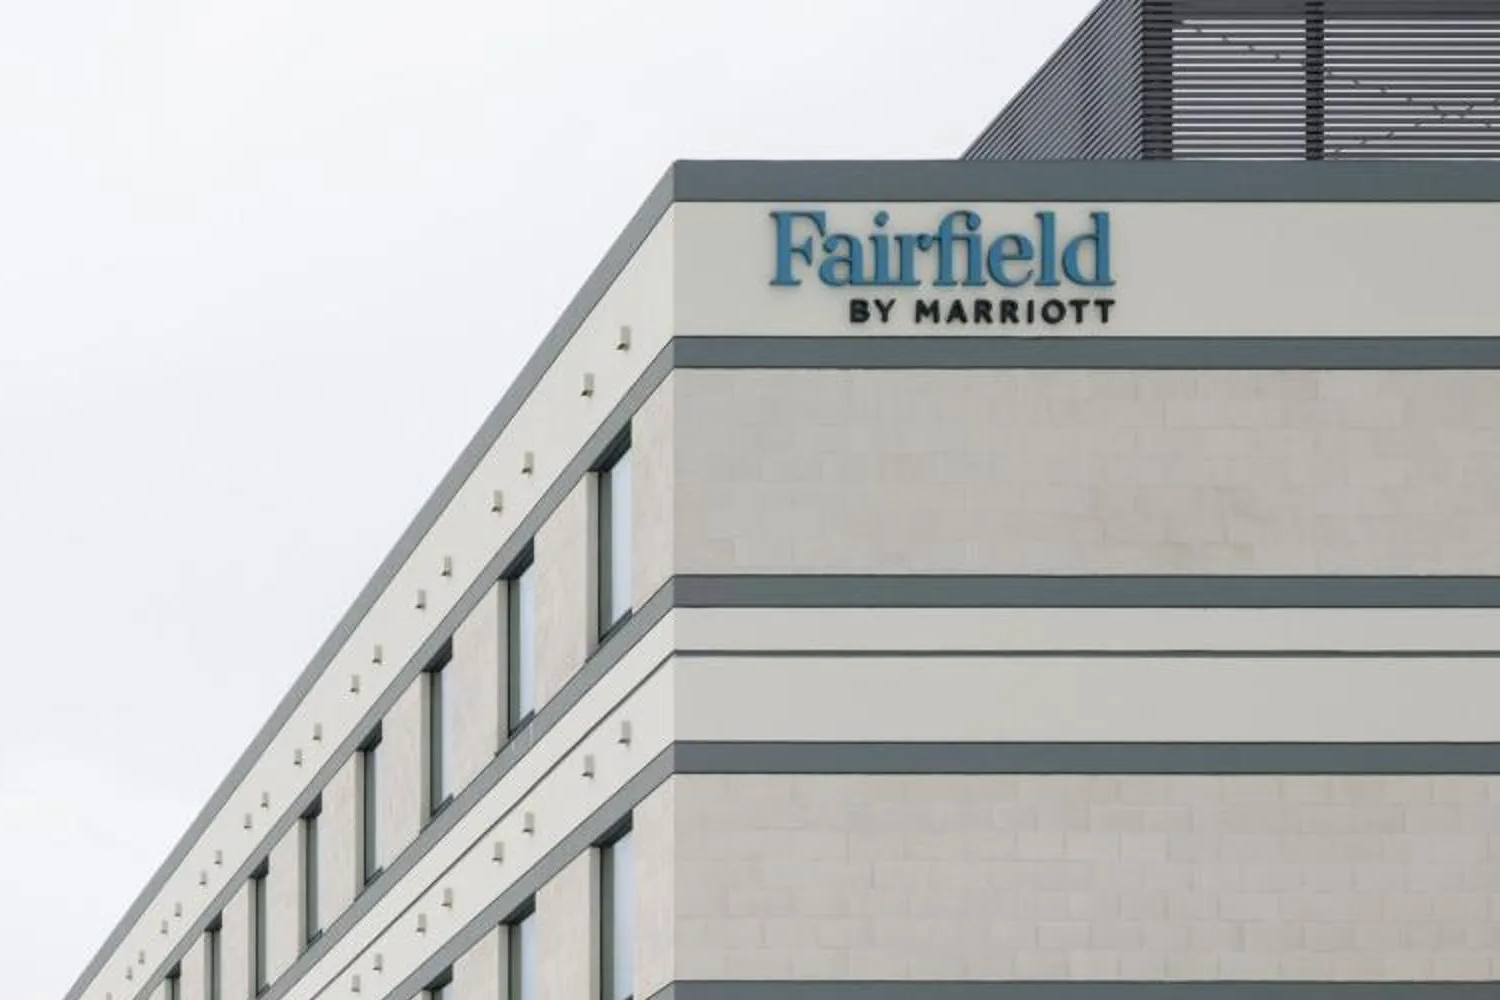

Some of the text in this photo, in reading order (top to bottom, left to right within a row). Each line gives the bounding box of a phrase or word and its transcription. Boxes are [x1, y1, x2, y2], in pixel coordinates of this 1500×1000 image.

[769, 209, 1116, 288] Fairfield
[849, 298, 1116, 325] BY MARRIOTT
